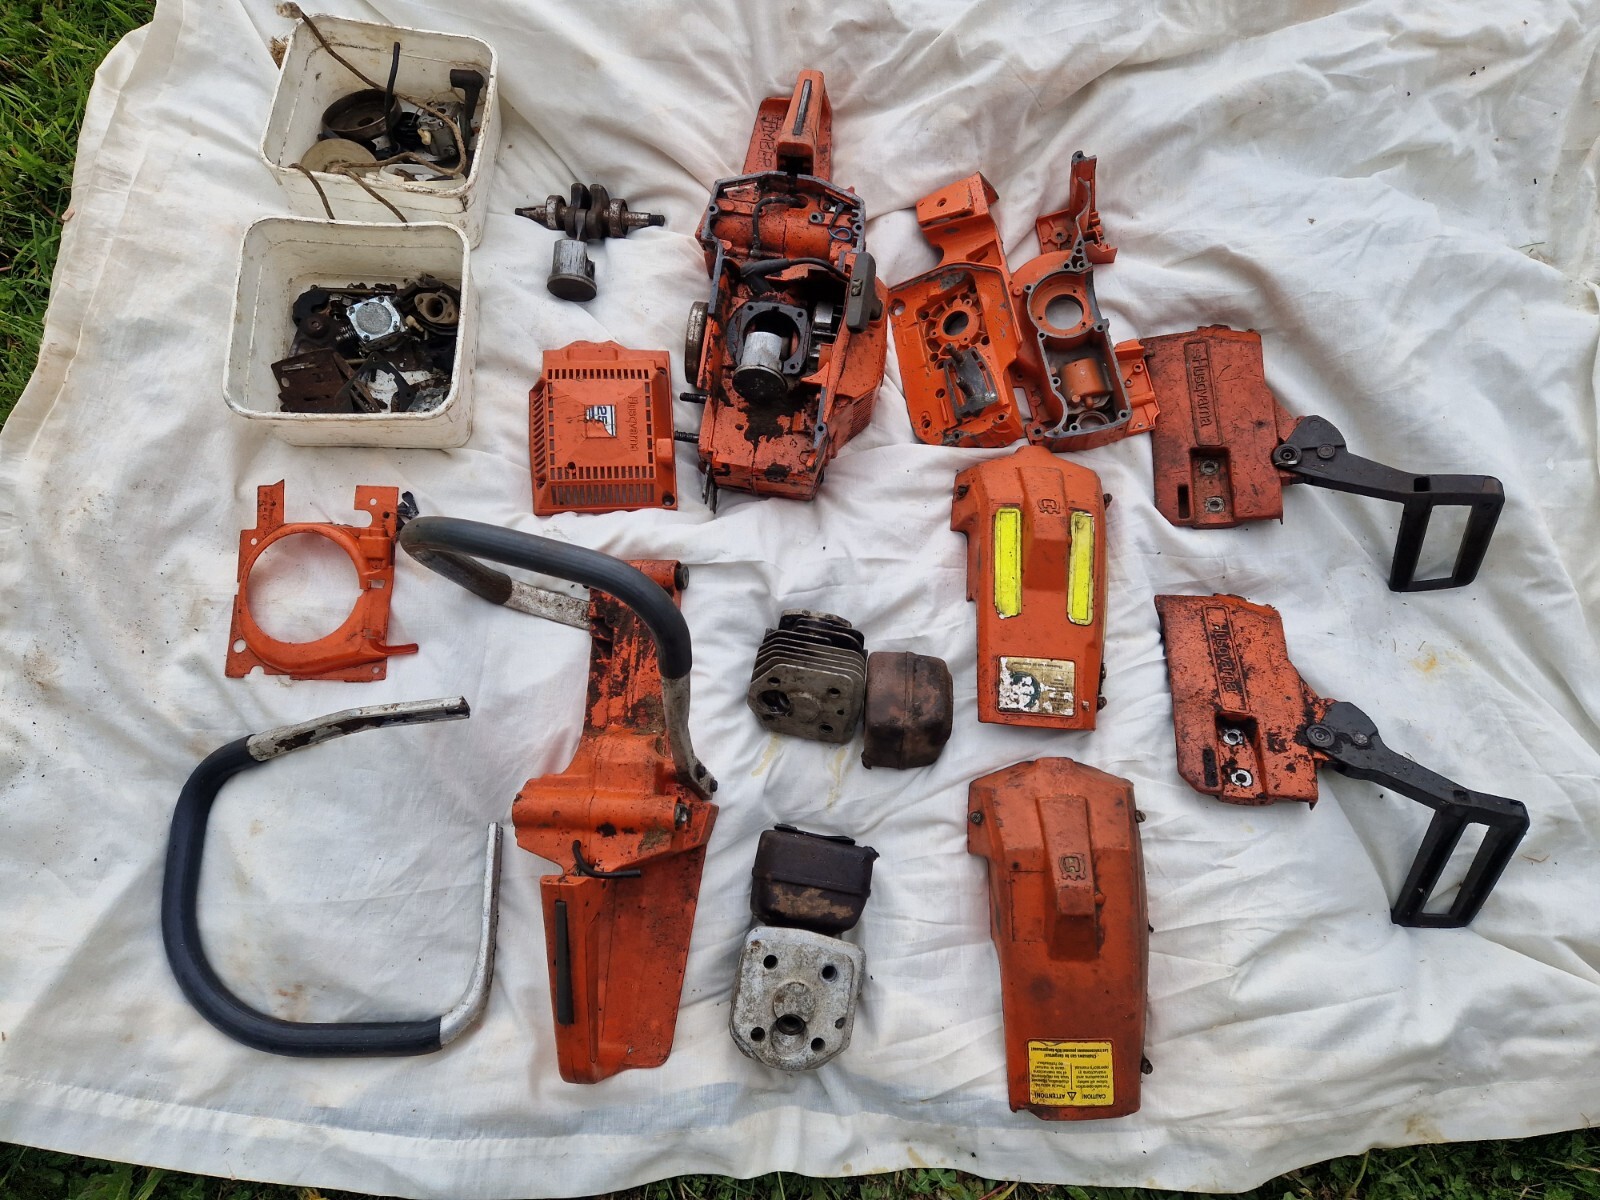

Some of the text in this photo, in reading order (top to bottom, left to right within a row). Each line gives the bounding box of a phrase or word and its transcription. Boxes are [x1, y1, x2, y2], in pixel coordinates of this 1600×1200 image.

[625, 395, 639, 452] Husqvarna
[1192, 358, 1213, 428] Husqvarna
[1212, 622, 1238, 694] Husqvarna
